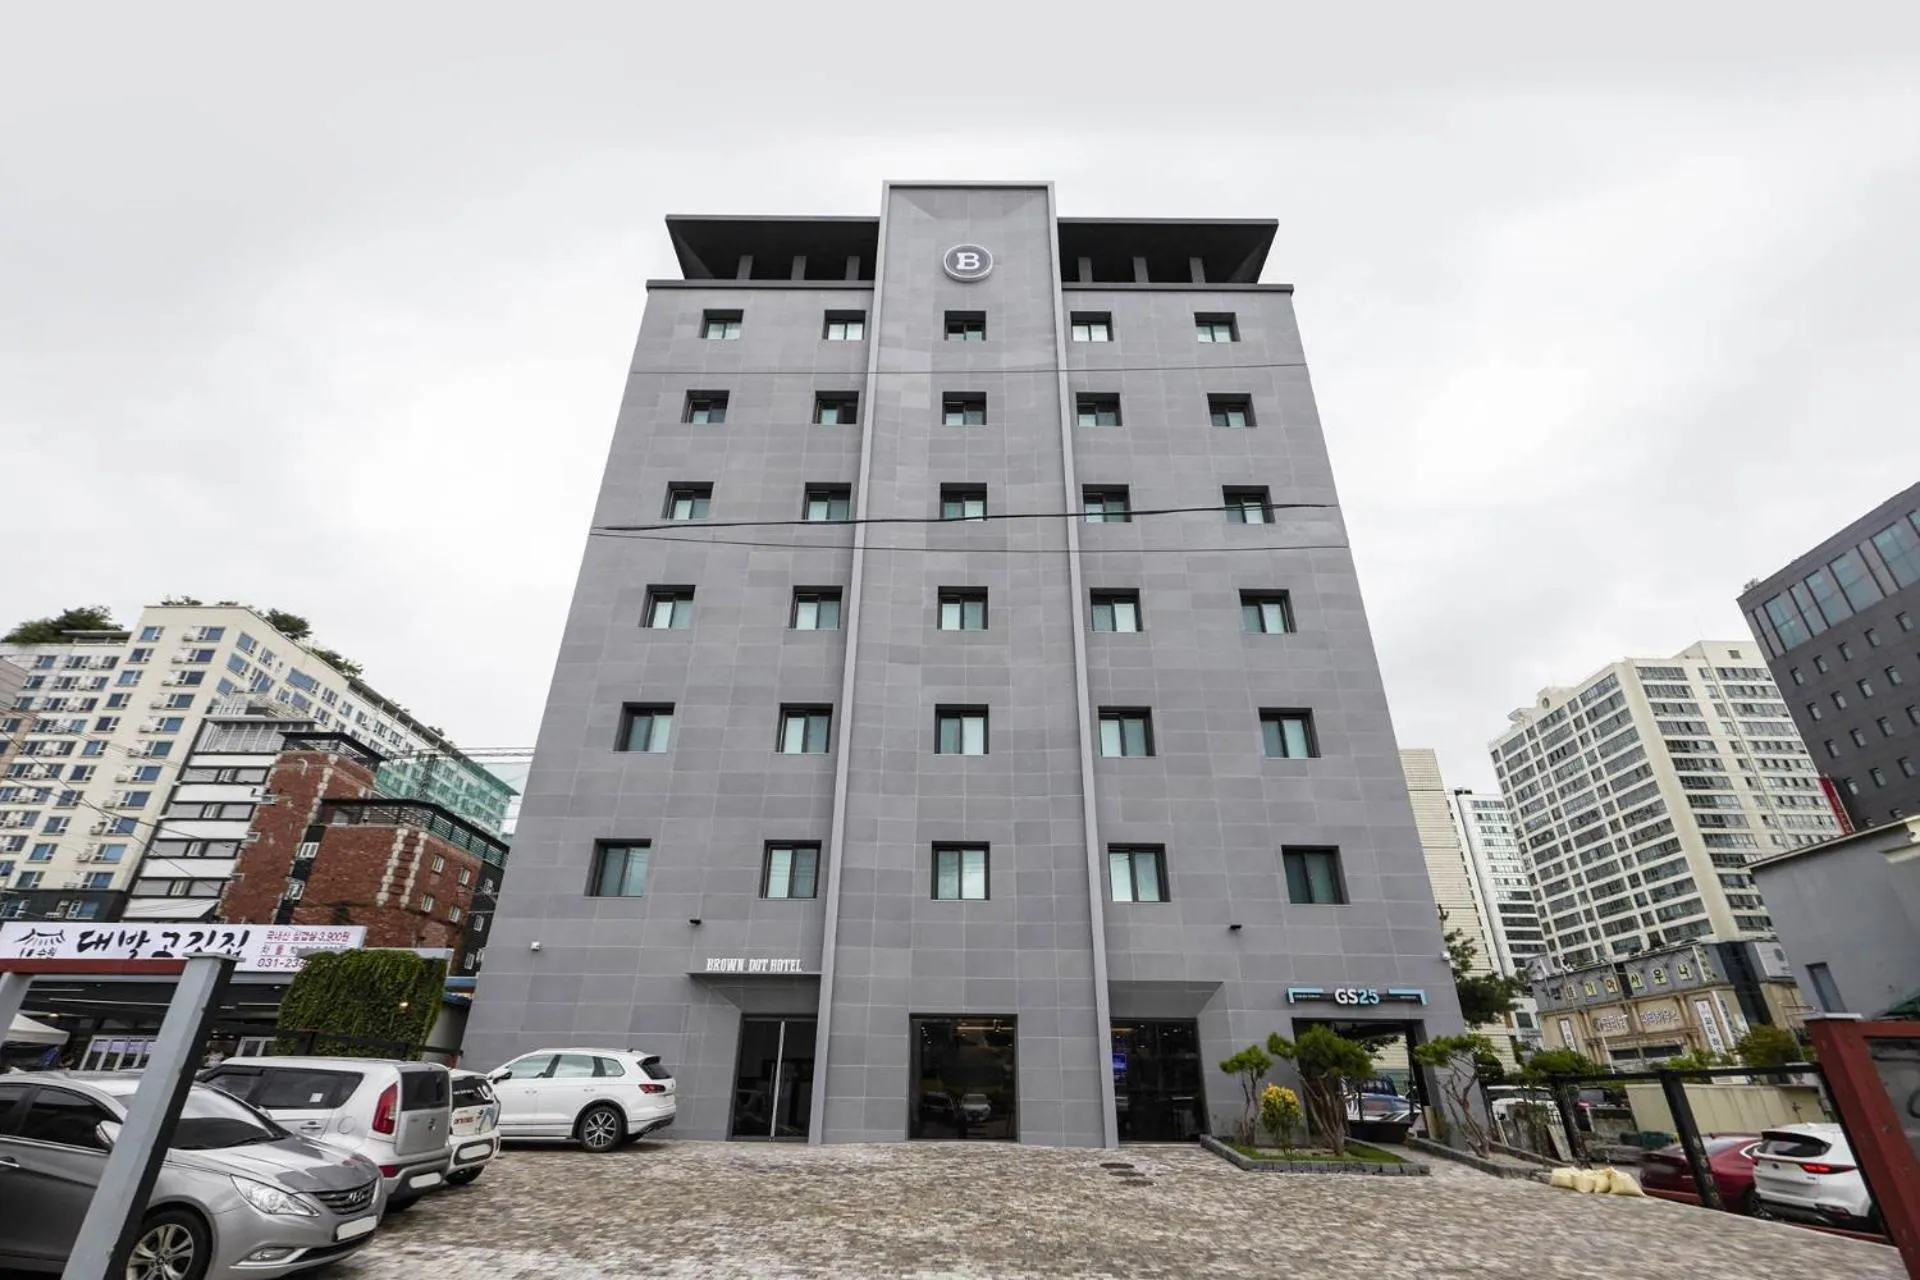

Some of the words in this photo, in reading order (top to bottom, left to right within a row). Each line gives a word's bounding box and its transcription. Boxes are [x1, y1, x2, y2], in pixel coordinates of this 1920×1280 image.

[956, 252, 980, 270] B
[706, 958, 745, 972] BROWN
[749, 958, 768, 972] DOT
[770, 958, 802, 973] HOTEL
[1334, 987, 1380, 1005] GS25
